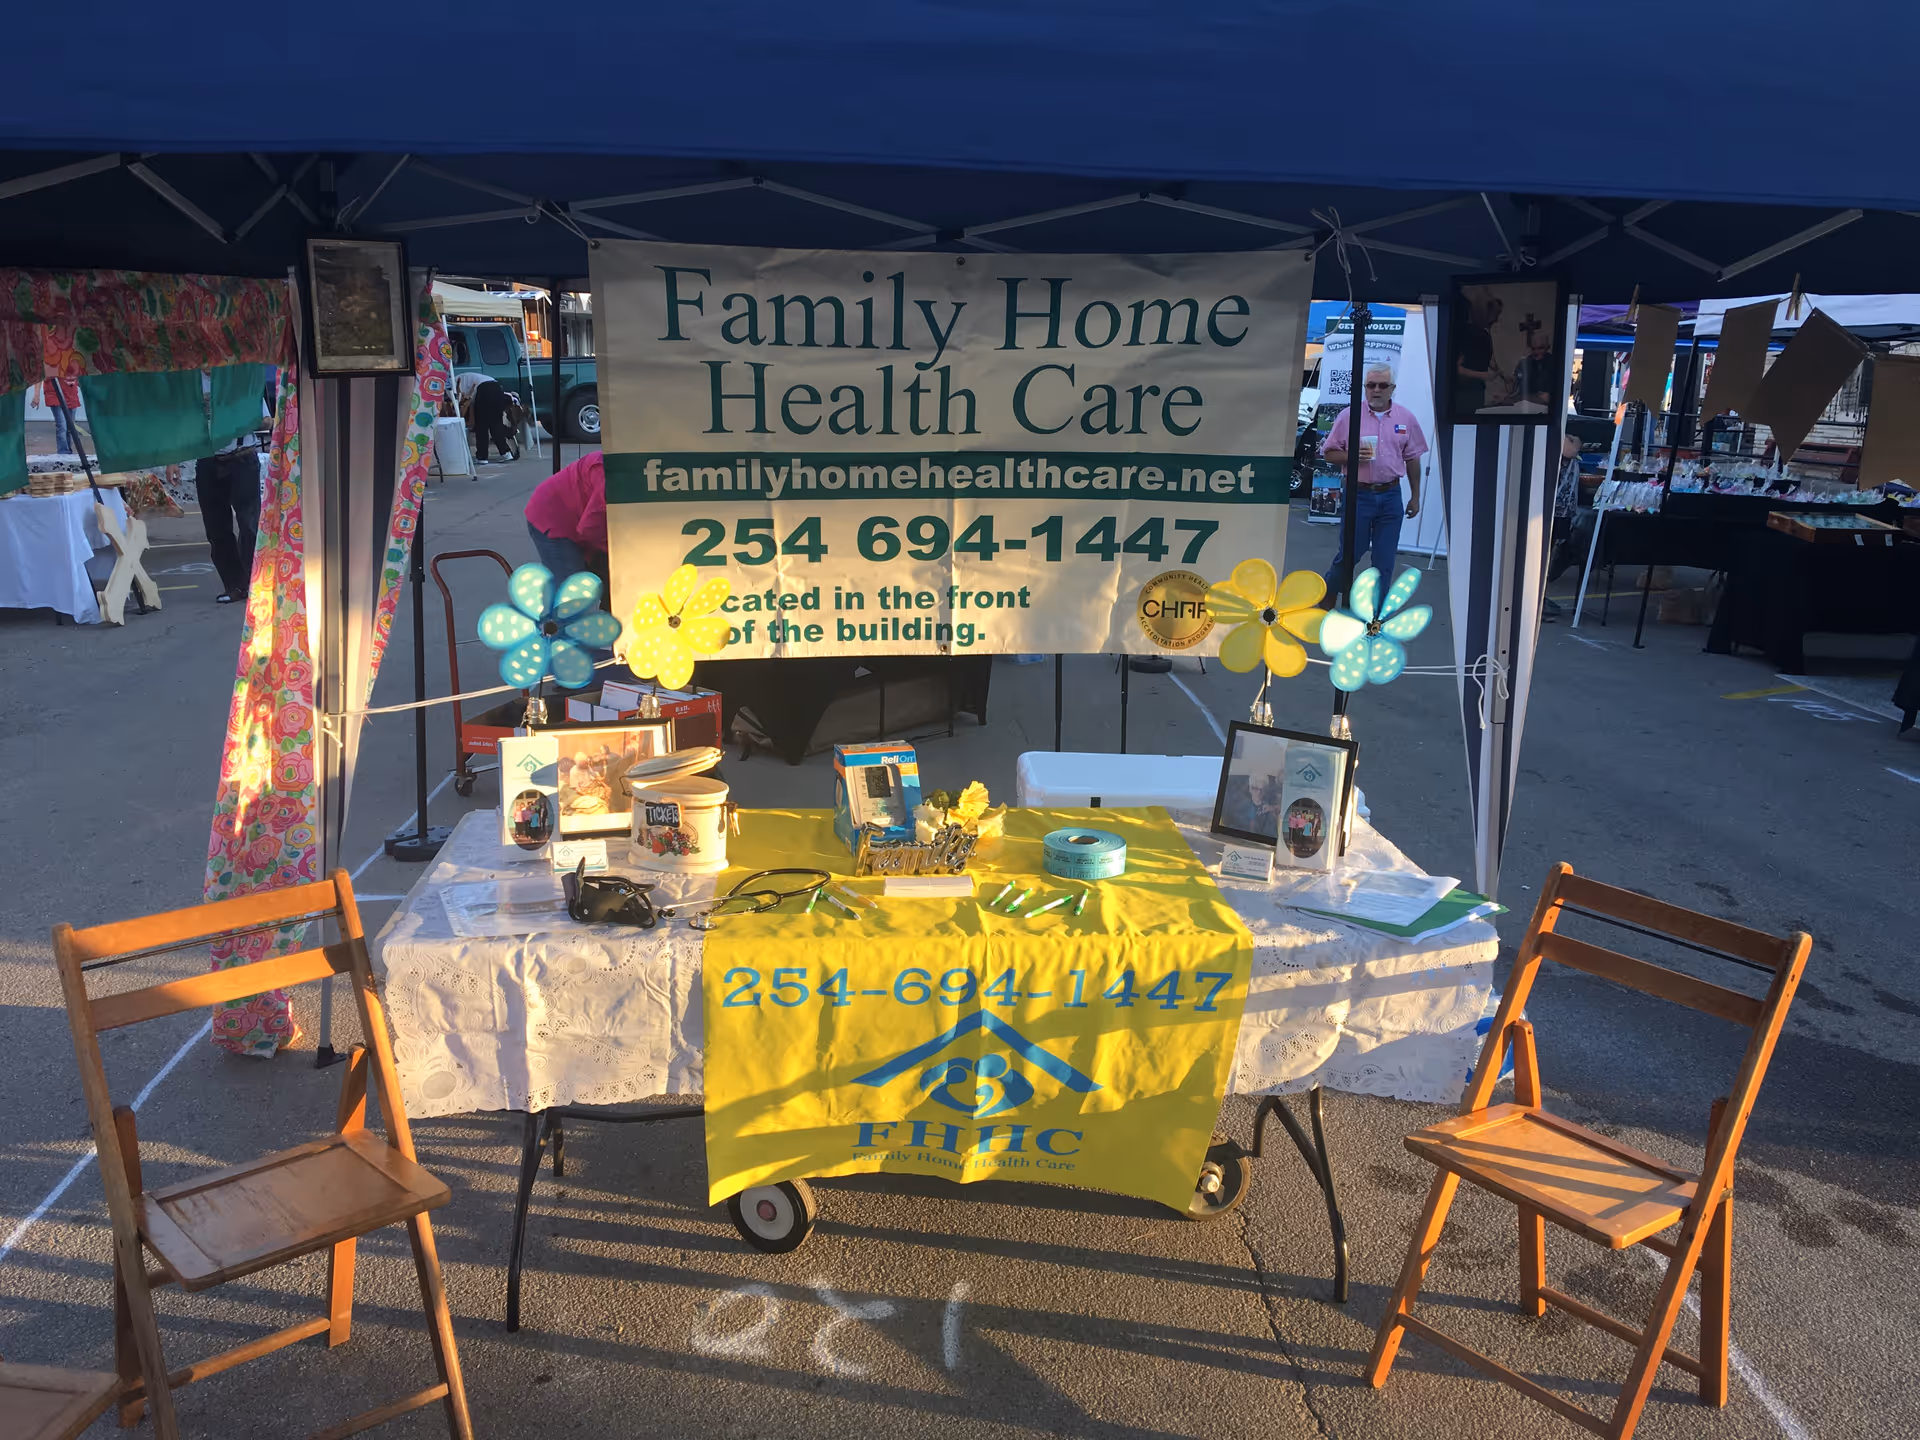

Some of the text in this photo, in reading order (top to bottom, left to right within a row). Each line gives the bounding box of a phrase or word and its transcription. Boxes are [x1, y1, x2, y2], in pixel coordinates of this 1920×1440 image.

[654, 265, 1251, 371] Family Home
[700, 359, 1206, 437] Health Care
[642, 459, 1255, 499] familyhomehealthcare.net
[680, 514, 1220, 567] 254 694-1447
[719, 585, 1031, 613] cated in the front
[1145, 573, 1208, 594] COMMUNITY HEALT
[727, 617, 986, 647] of the building.
[1140, 616, 1186, 647] ACCREDITATION
[880, 755, 914, 765] ReliOn
[645, 805, 679, 824] TICKETS
[722, 966, 1234, 1012] 254-694-1447
[852, 1119, 1084, 1156] FHHC
[851, 1150, 1076, 1171] Family Home Health Care
